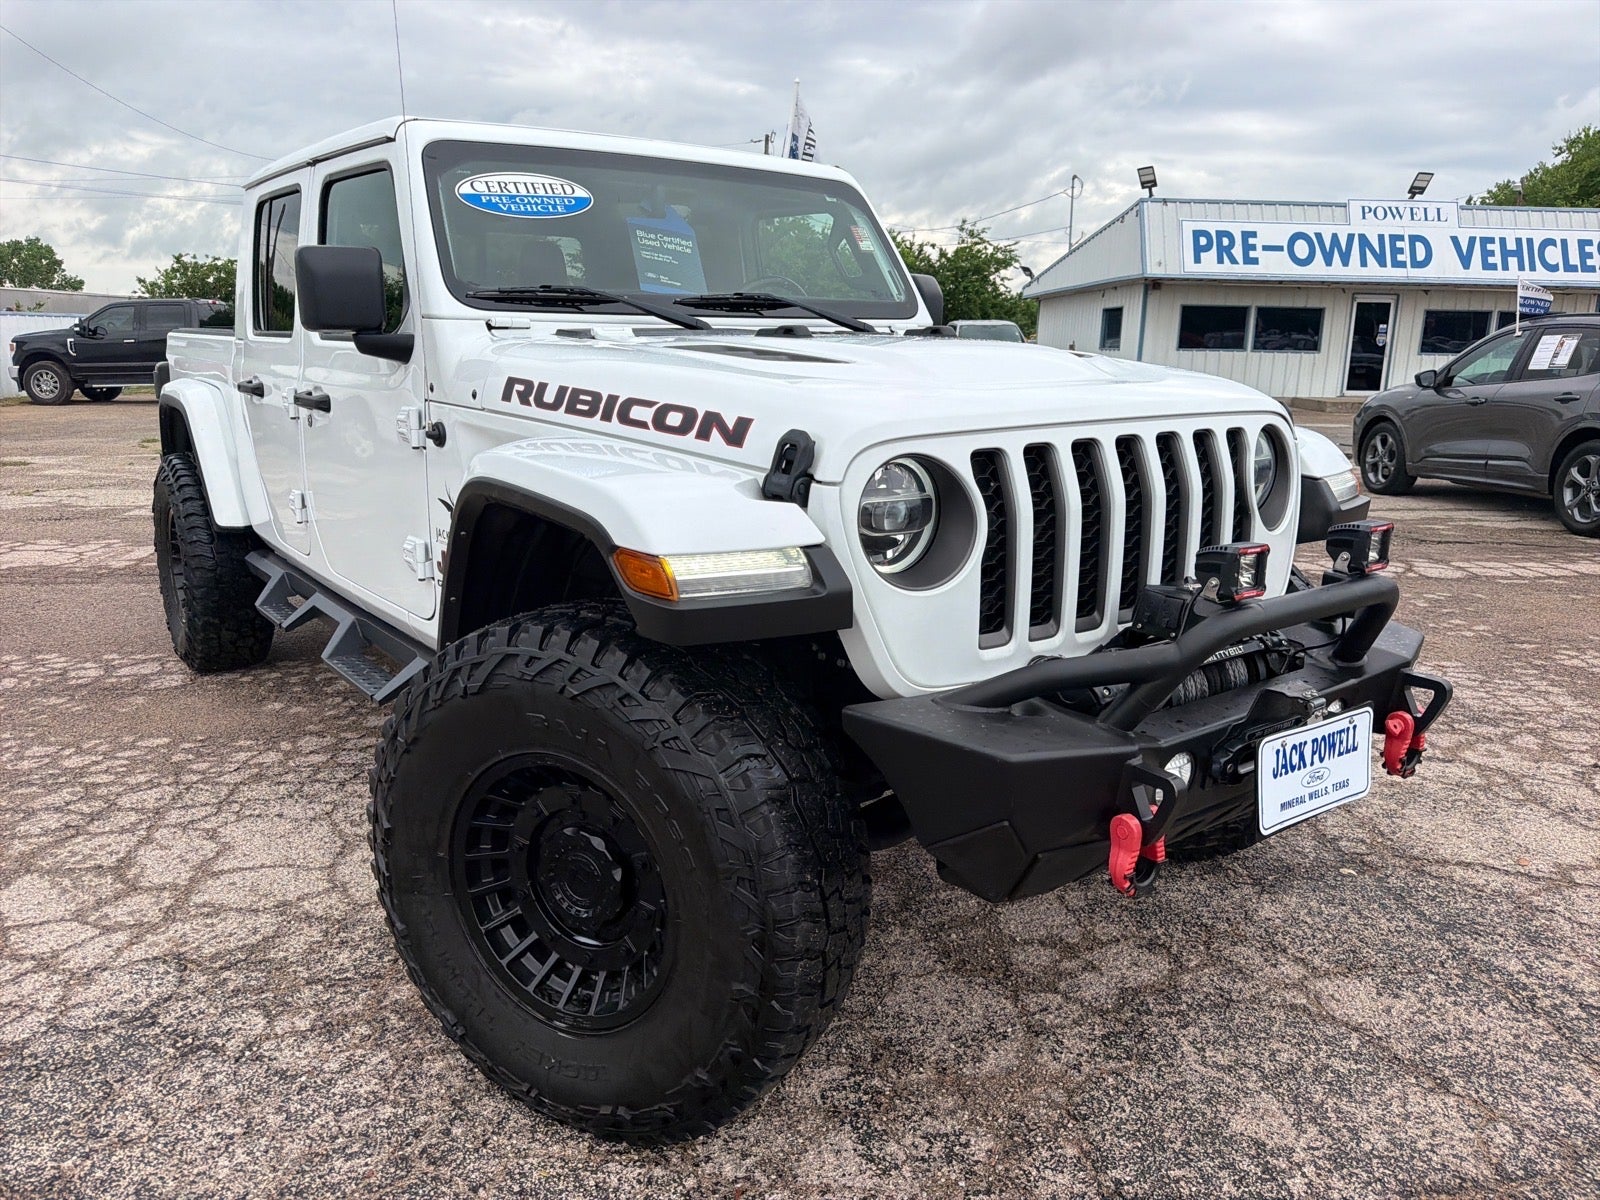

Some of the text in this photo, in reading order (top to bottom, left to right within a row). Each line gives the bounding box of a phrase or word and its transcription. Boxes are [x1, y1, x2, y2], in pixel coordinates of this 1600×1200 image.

[470, 180, 576, 196] CERTIFIED
[480, 195, 576, 206] PRE-OWNED
[498, 203, 567, 213] VEHICLE
[1360, 205, 1448, 222] POWELL
[636, 229, 693, 248] Blue Certified
[637, 237, 692, 254] Used Vehicle
[1191, 229, 1600, 273] PRE-OWNED VEHICLE
[500, 375, 755, 449] RUBICON
[1203, 645, 1243, 664] ITTYBILT
[1272, 723, 1359, 780] JACK POWELL
[1306, 769, 1326, 785] Ford
[1280, 778, 1350, 812] MINERAL WELLS, TEXAS
